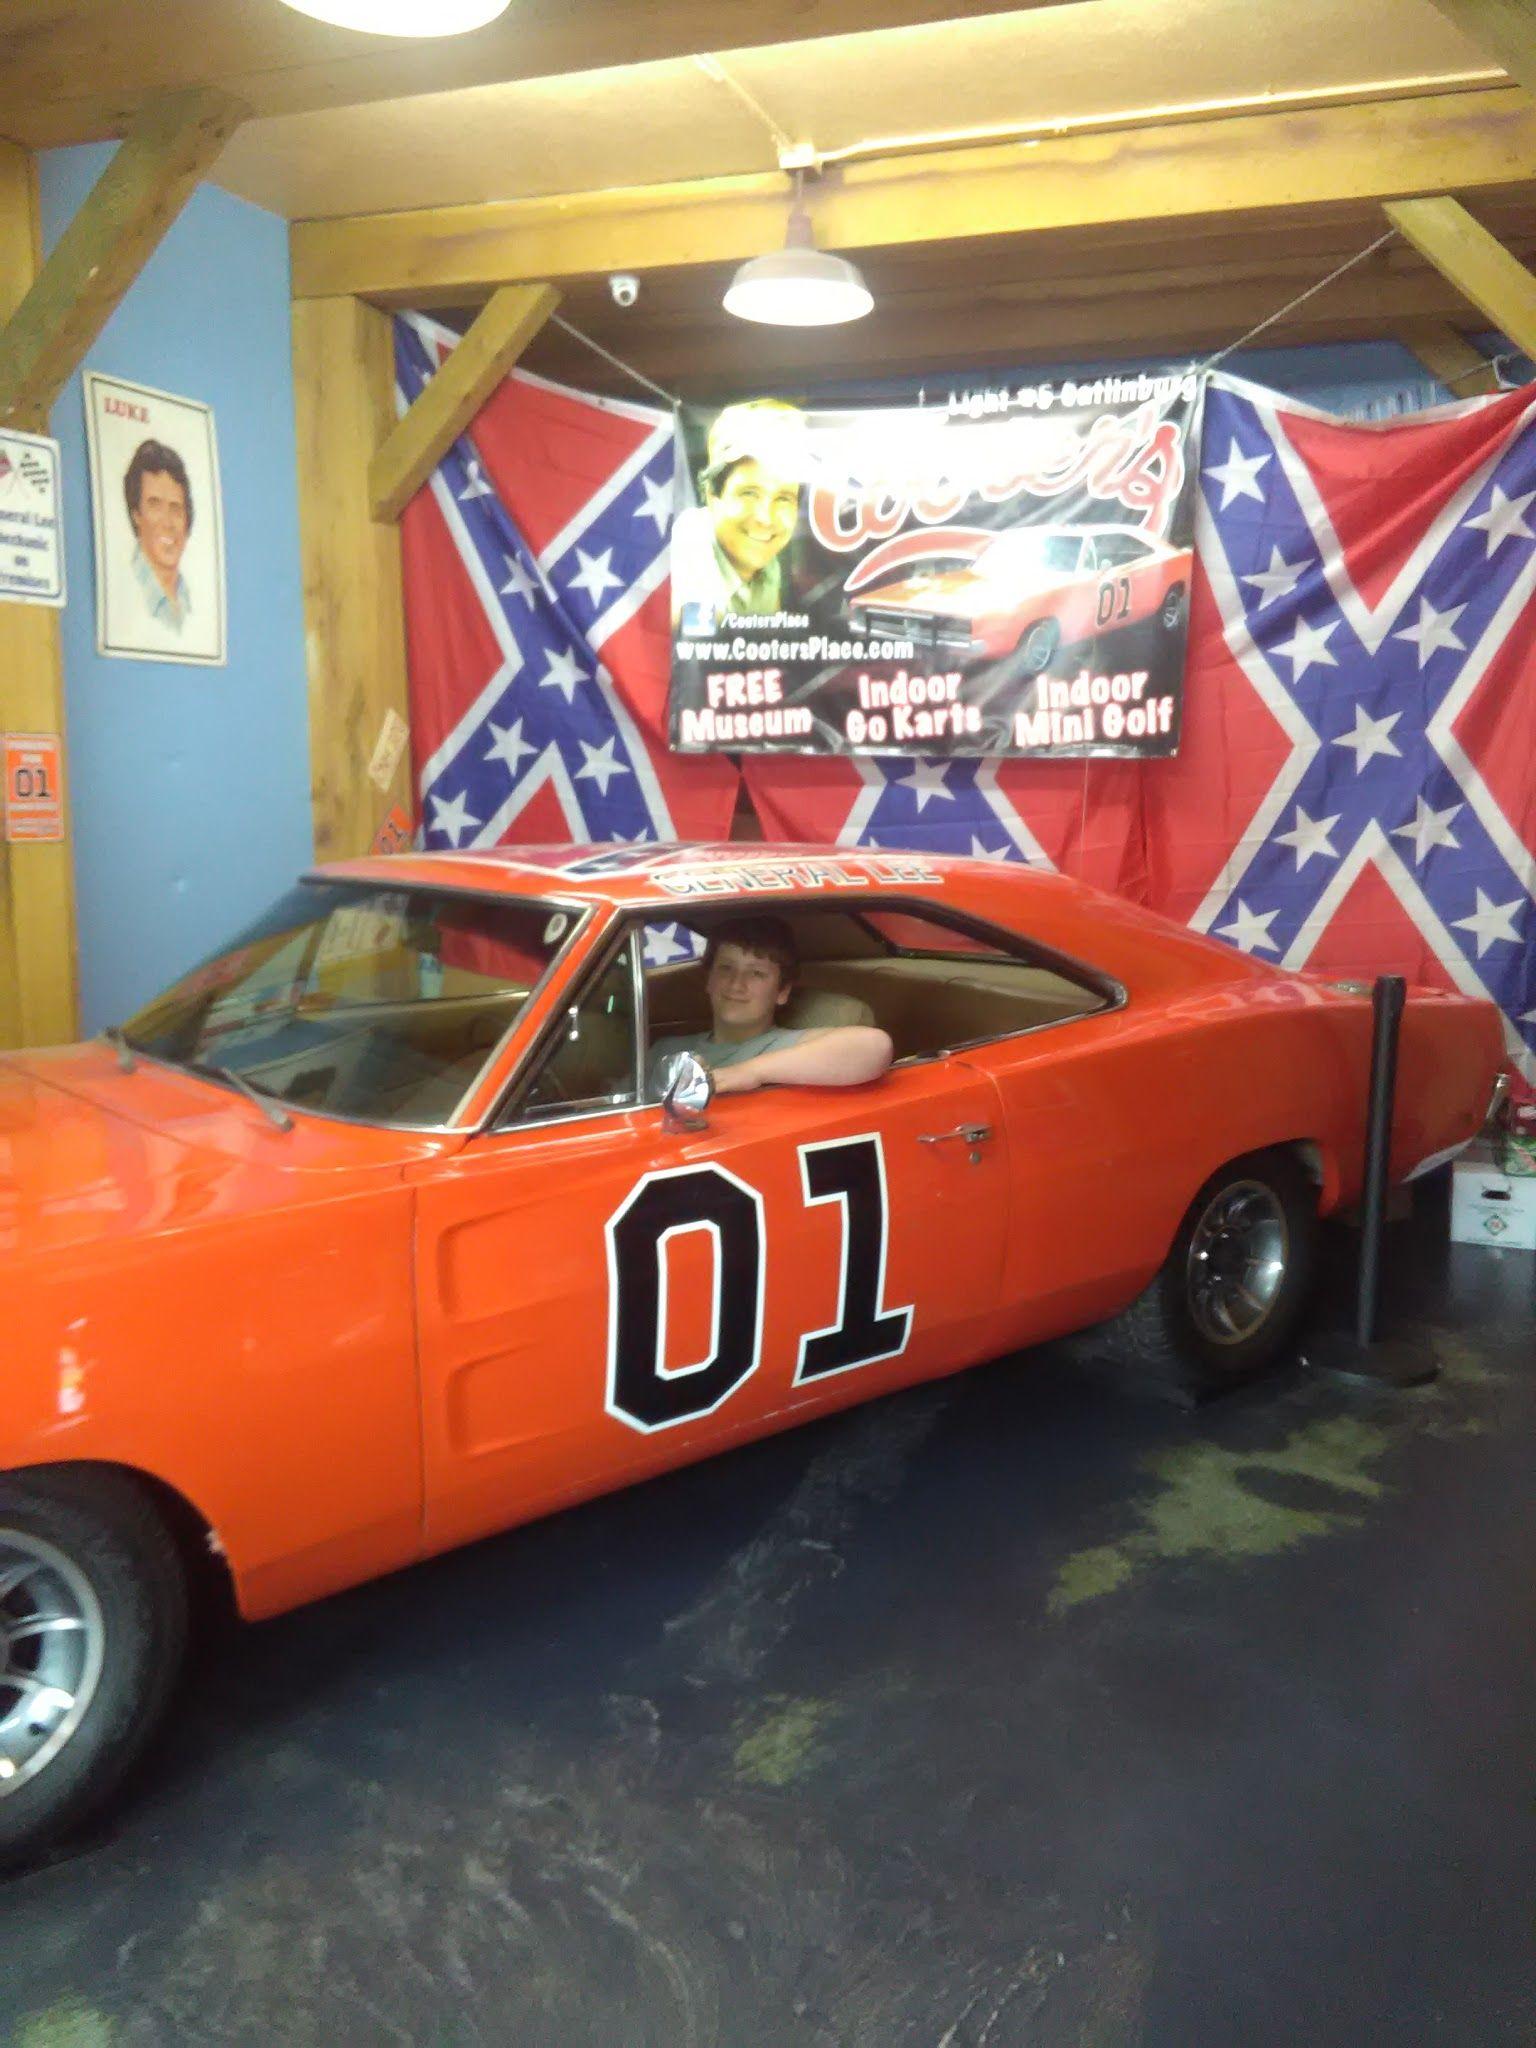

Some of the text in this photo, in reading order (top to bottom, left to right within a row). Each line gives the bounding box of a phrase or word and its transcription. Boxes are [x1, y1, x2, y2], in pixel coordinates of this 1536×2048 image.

[104, 396, 150, 424] LUKE
[1096, 576, 1130, 627] 01
[677, 636, 914, 661] www.CootersPlace.com
[706, 668, 783, 708] FREE
[858, 670, 962, 709] Indoor
[1036, 670, 1149, 709] Indoor
[681, 707, 814, 743] Museum
[846, 703, 982, 743] Go Karts
[1014, 696, 1174, 747] Mini Golf
[15, 767, 50, 798] 01
[652, 858, 944, 895] GENERAL LEE
[604, 1131, 915, 1435] 01
